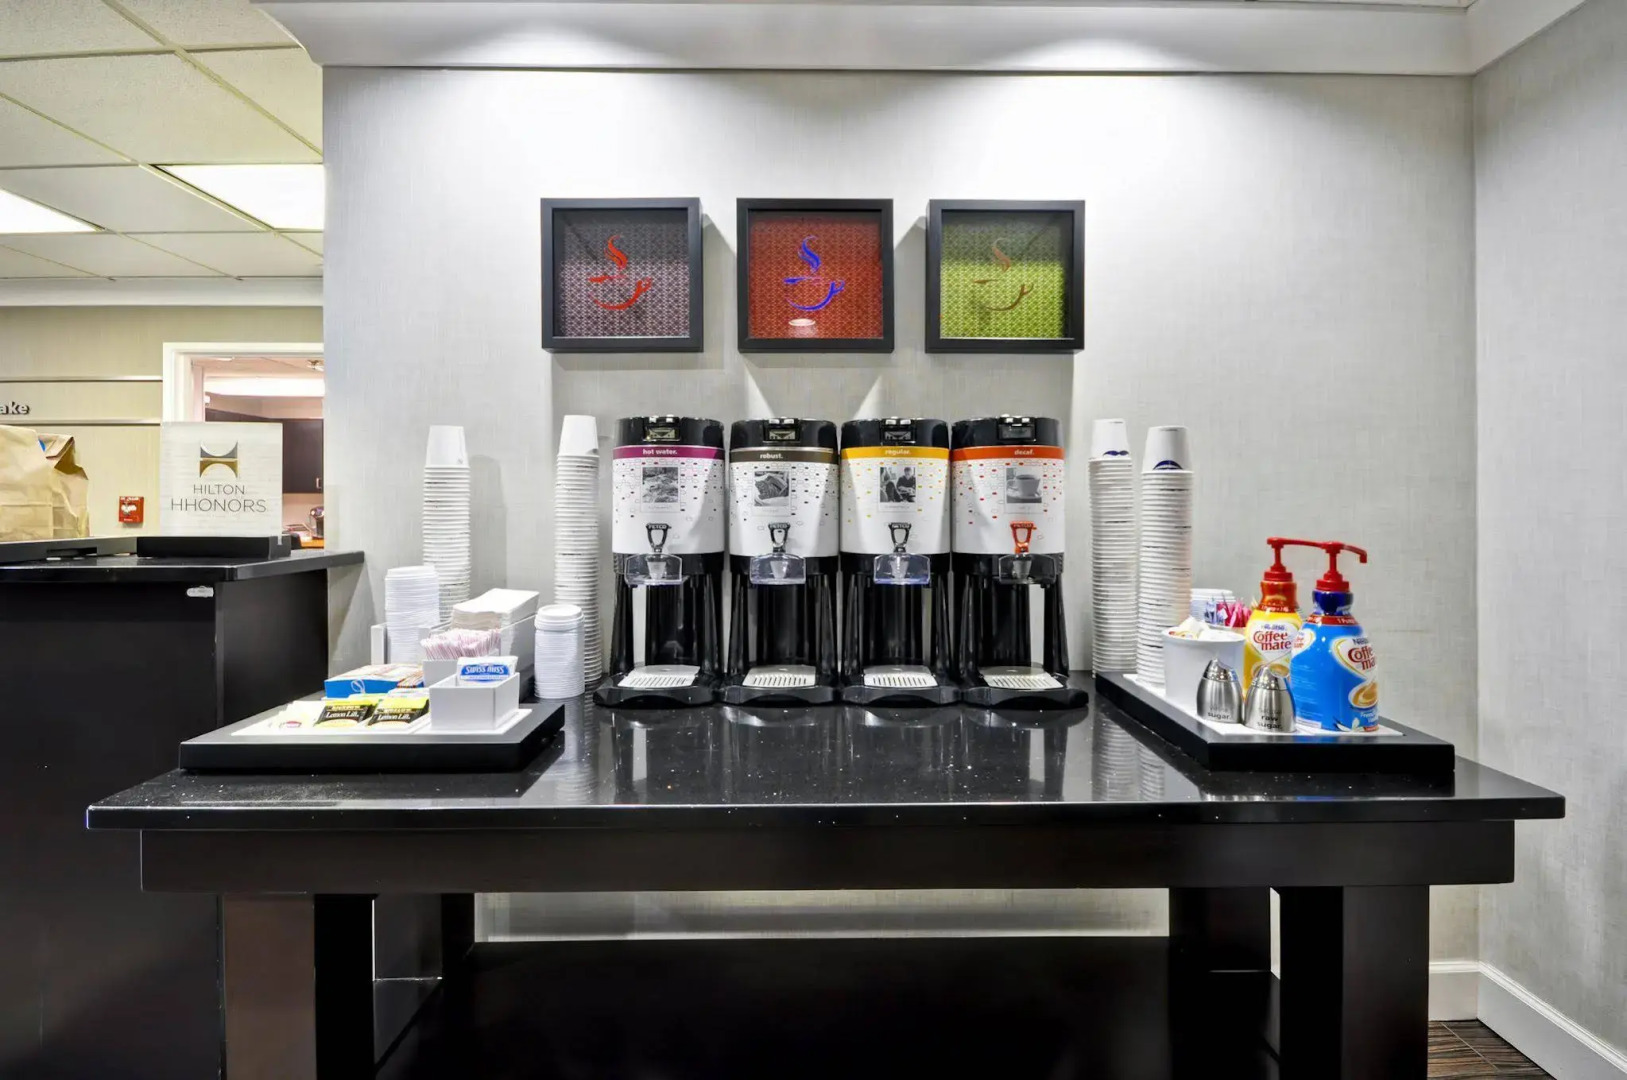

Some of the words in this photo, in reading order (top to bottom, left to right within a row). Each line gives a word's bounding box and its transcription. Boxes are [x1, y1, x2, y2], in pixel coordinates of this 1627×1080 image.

[193, 484, 245, 495] HILTON
[171, 498, 267, 512] HHONORS
[1253, 631, 1288, 643] Coffee
[1261, 640, 1292, 651] mate
[1348, 645, 1374, 663] Coffe
[325, 711, 346, 719] Lemon
